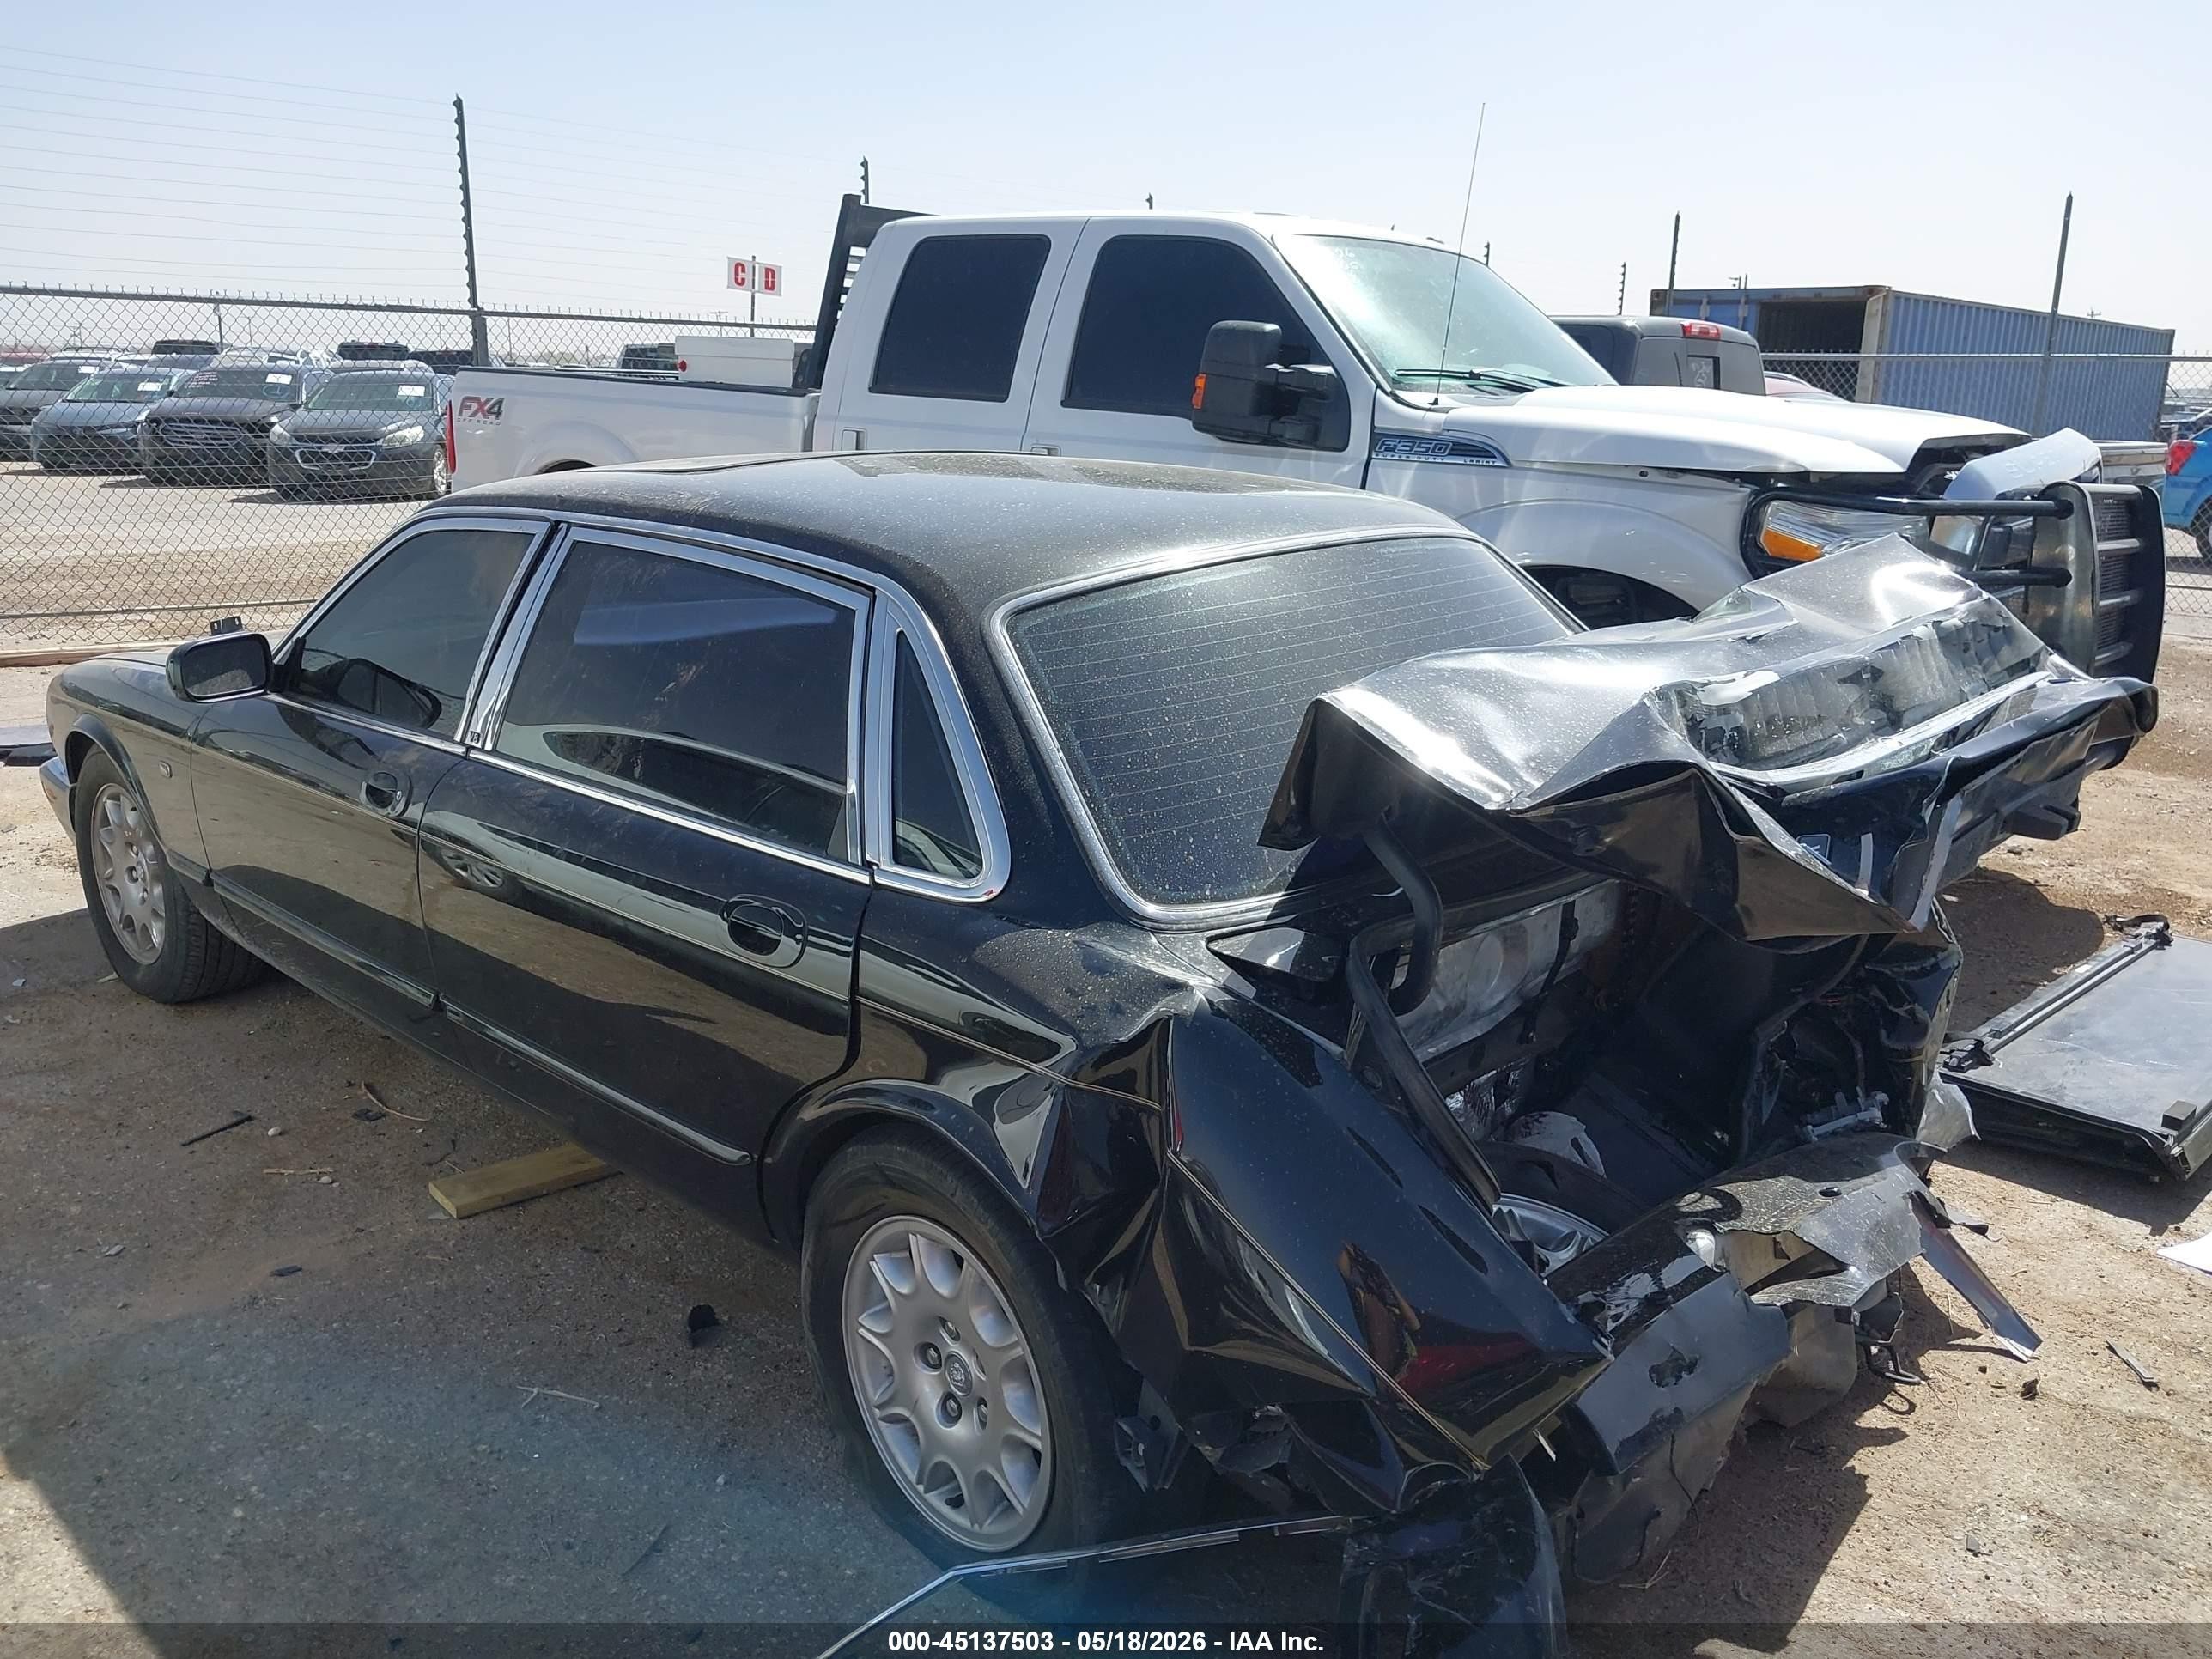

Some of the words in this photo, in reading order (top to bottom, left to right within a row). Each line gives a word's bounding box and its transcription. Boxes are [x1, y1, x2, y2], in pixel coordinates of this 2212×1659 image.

[734, 262, 745, 286] C
[764, 267, 775, 291] D
[458, 396, 505, 420] FX4
